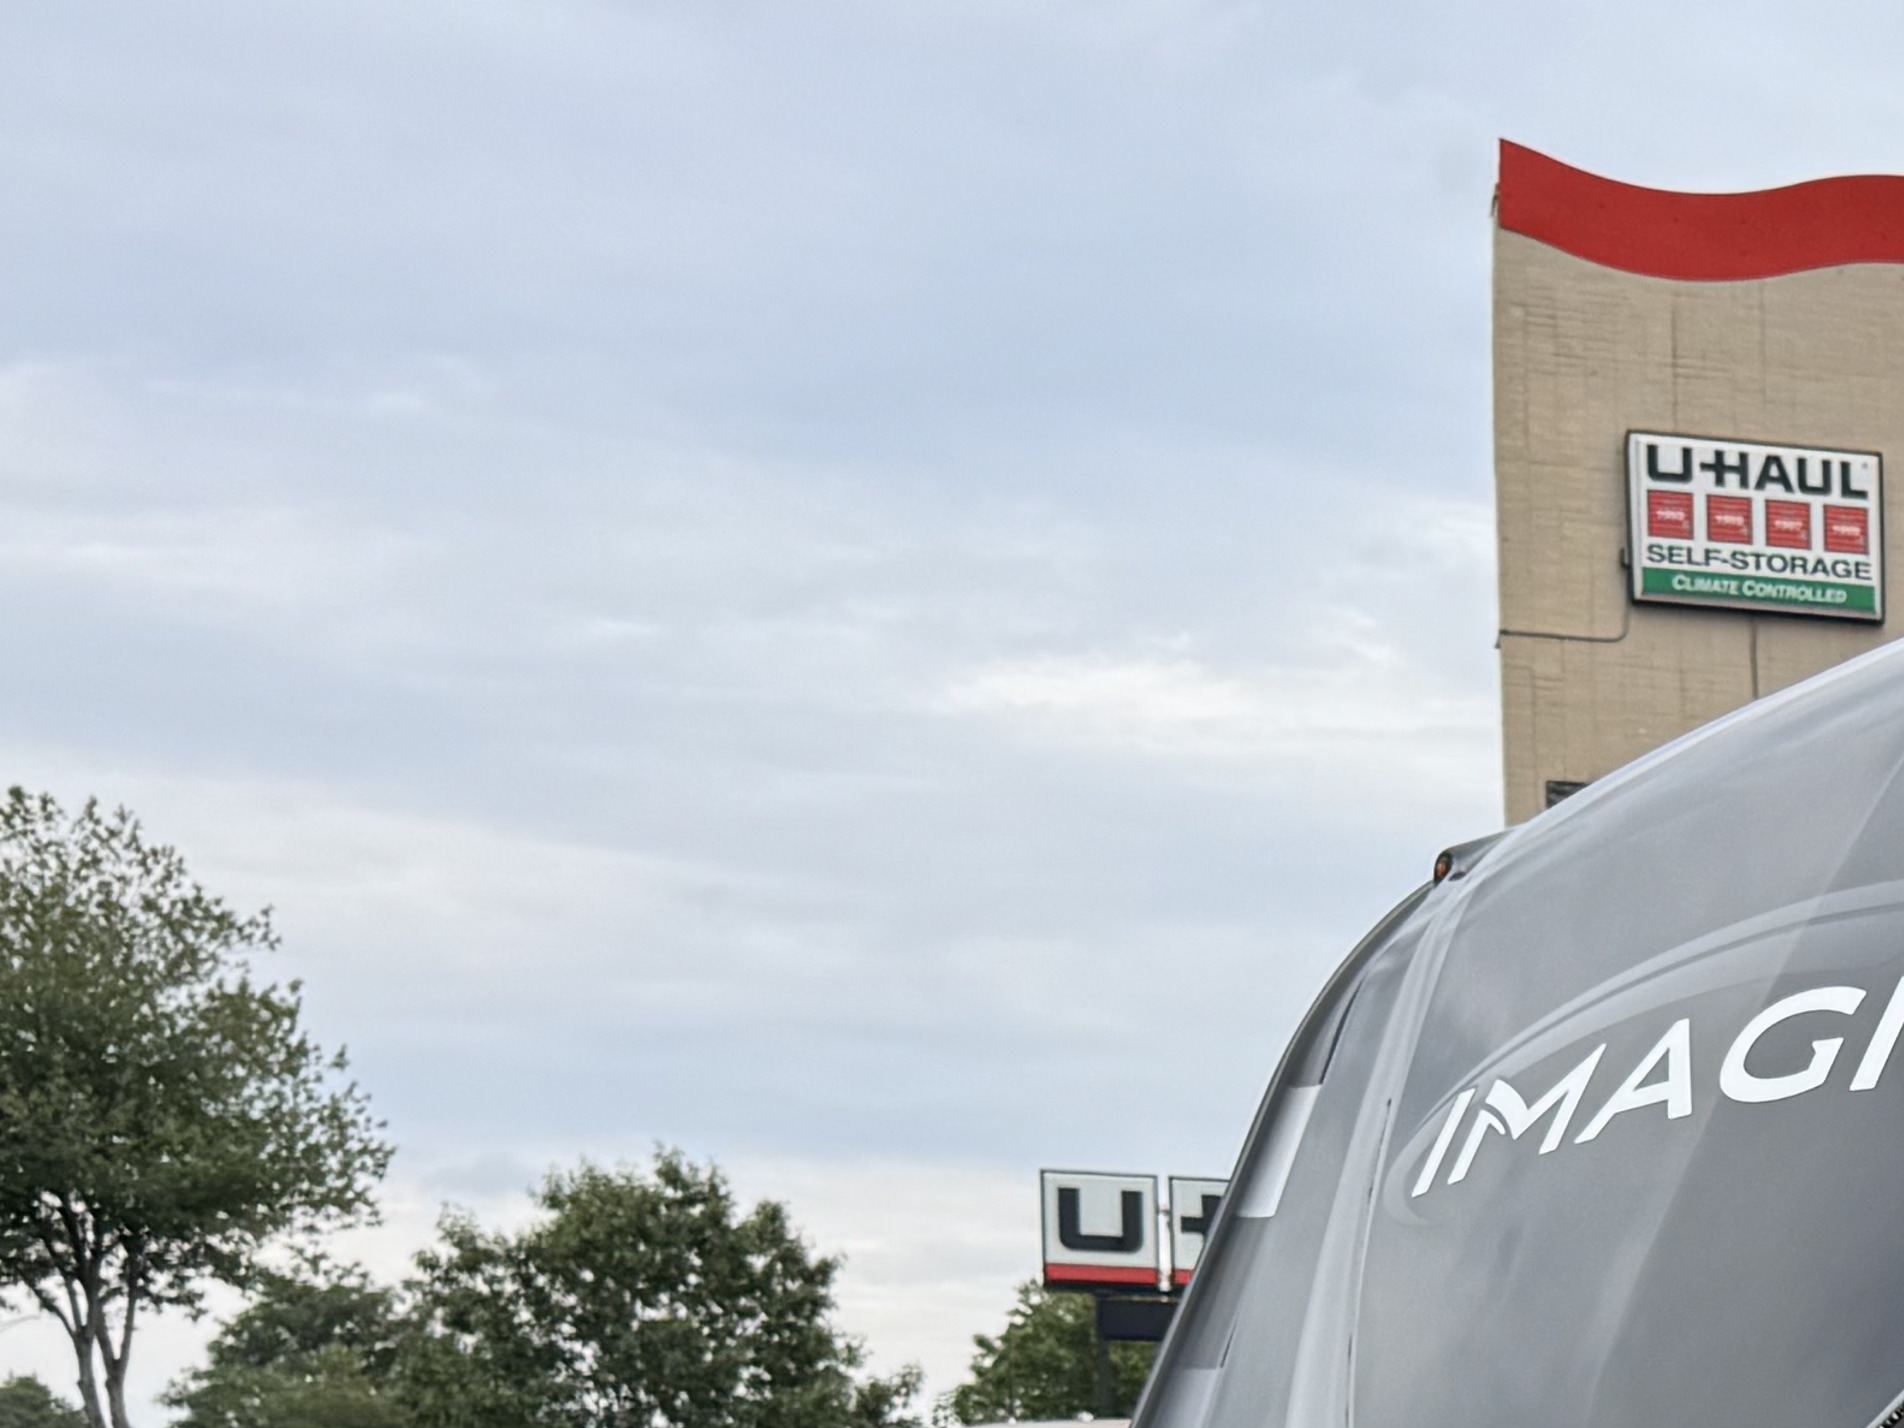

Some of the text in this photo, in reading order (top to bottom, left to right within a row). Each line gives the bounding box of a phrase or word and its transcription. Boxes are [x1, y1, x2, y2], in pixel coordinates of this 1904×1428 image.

[1646, 444, 1868, 499] U-HAUL
[1647, 544, 1873, 580] SELF-STORAGE
[1672, 574, 1847, 604] CLIMATE CONTROLLED
